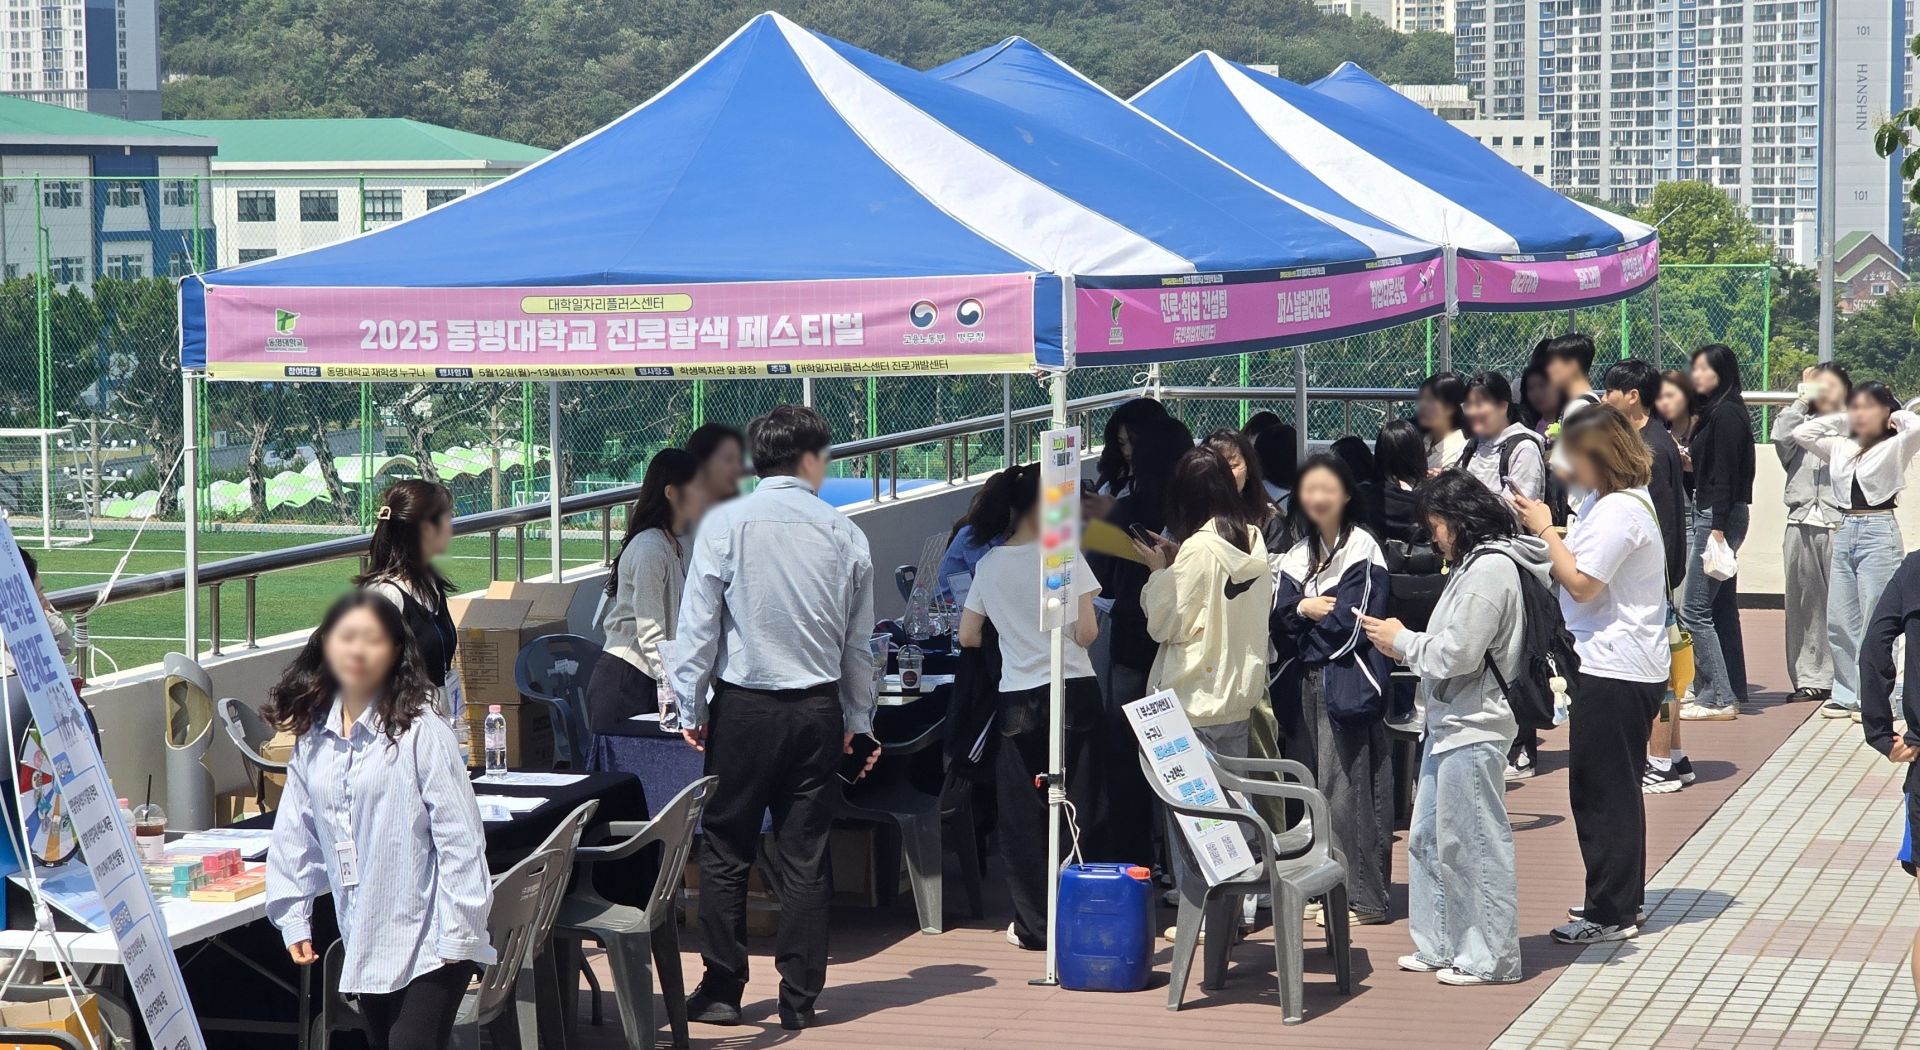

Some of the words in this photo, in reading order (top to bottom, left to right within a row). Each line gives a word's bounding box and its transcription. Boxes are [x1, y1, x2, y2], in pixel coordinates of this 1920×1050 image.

[1856, 26, 1870, 36] 101
[1856, 64, 1868, 131] HANSHIN
[1854, 190, 1868, 201] 101
[548, 297, 664, 312] 대학일자리플러스센터
[1202, 289, 1228, 320] 컨설팅
[1277, 287, 1331, 324] 퍼스널컬러진단
[359, 319, 439, 350] 2025
[447, 319, 598, 352] 동명대학교
[606, 316, 729, 351] 진로탐색
[736, 312, 865, 348] 페스티벌
[957, 331, 984, 343] 병무청
[268, 338, 304, 348] 동명대학교
[904, 333, 946, 345] 고용노동부
[287, 367, 318, 376] 참여대상
[327, 367, 370, 377] 동명대학교
[371, 367, 398, 377] 재학생
[400, 367, 426, 377] 누구나
[438, 368, 469, 377] 행사일시
[639, 367, 670, 376] 행사장소
[680, 366, 725, 376] 학생복지관
[727, 365, 736, 375] 앞
[739, 365, 757, 375] 광장
[771, 364, 787, 374] 주관
[796, 361, 890, 373] 대학일자리플러스센터
[891, 359, 949, 371] 진로개발센터
[9, 632, 58, 694] 지원제도
[1144, 725, 1162, 741] 누구나
